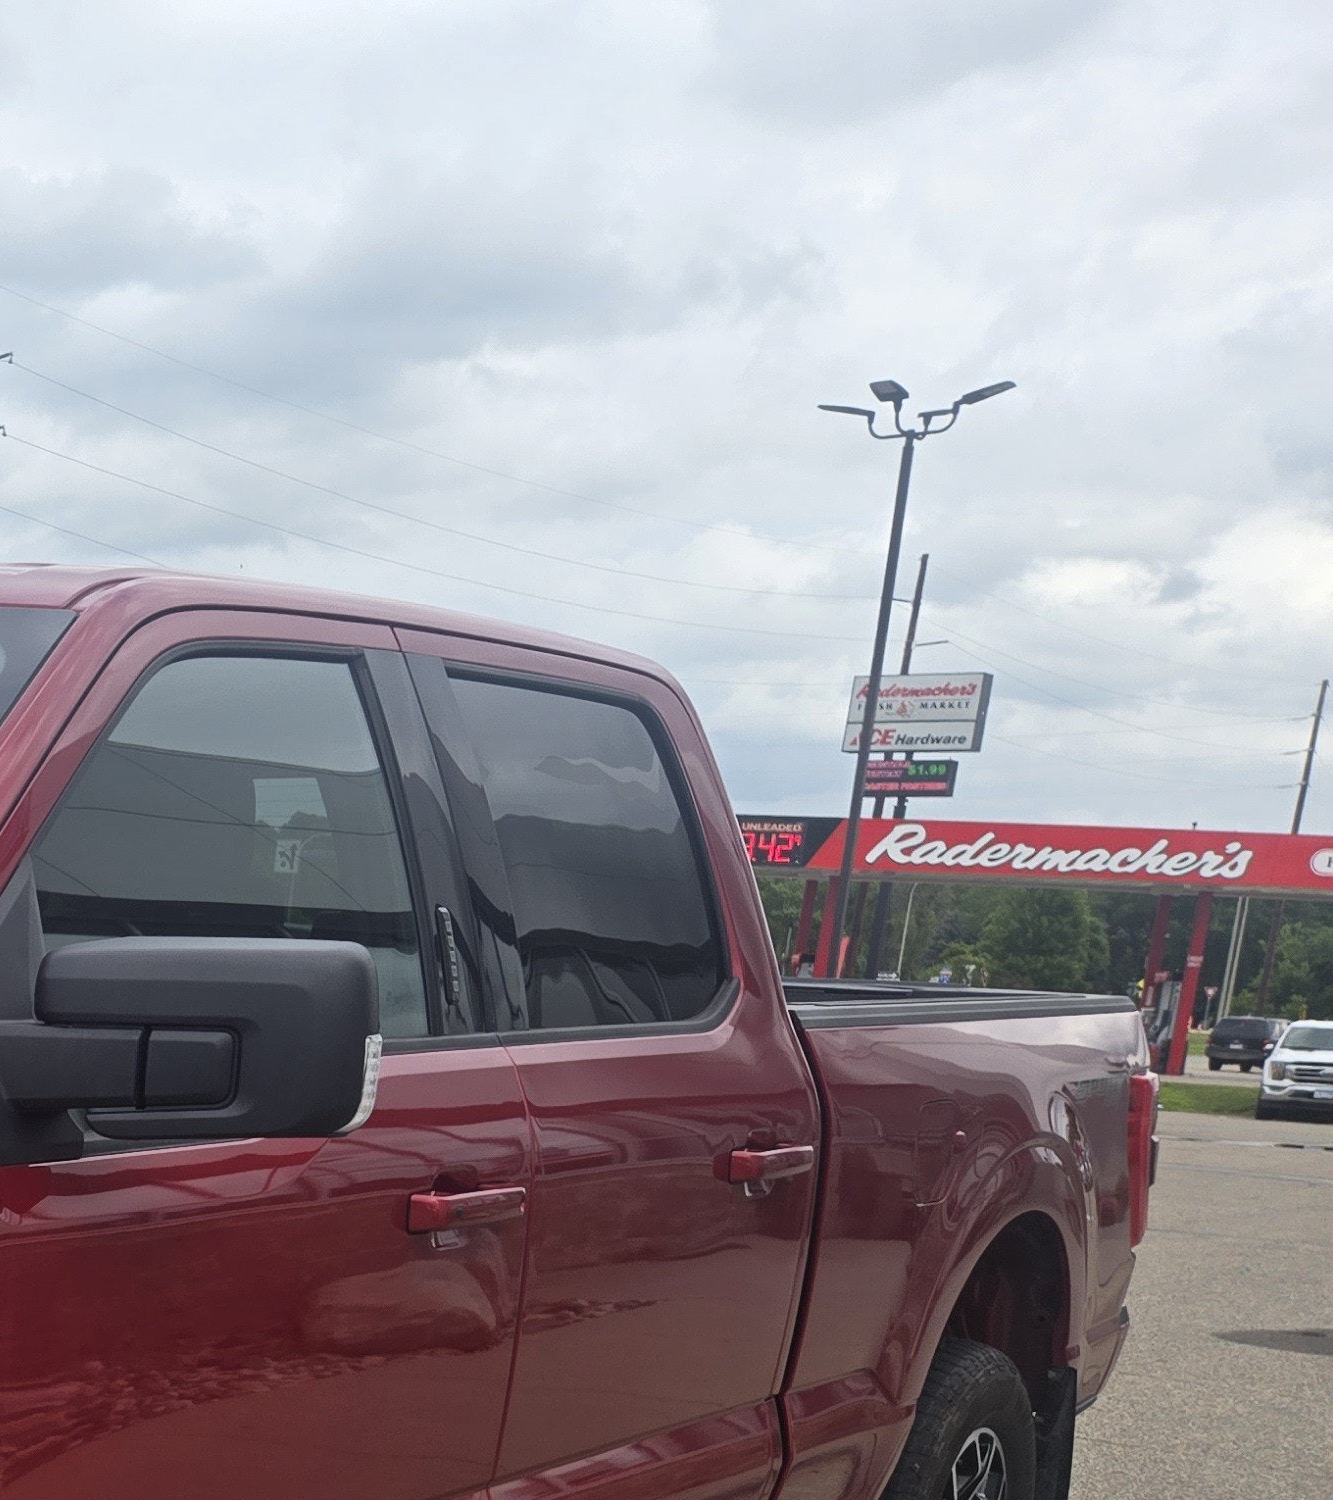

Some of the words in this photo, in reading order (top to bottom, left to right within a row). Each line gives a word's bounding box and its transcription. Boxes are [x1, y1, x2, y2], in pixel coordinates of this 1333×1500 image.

[856, 682, 978, 699] Rdermacher's
[857, 702, 894, 711] FSH
[920, 701, 971, 709] MARKET
[895, 733, 967, 746] Hardware
[742, 822, 803, 833] UNLEADED
[865, 823, 1253, 879] Radermacher's
